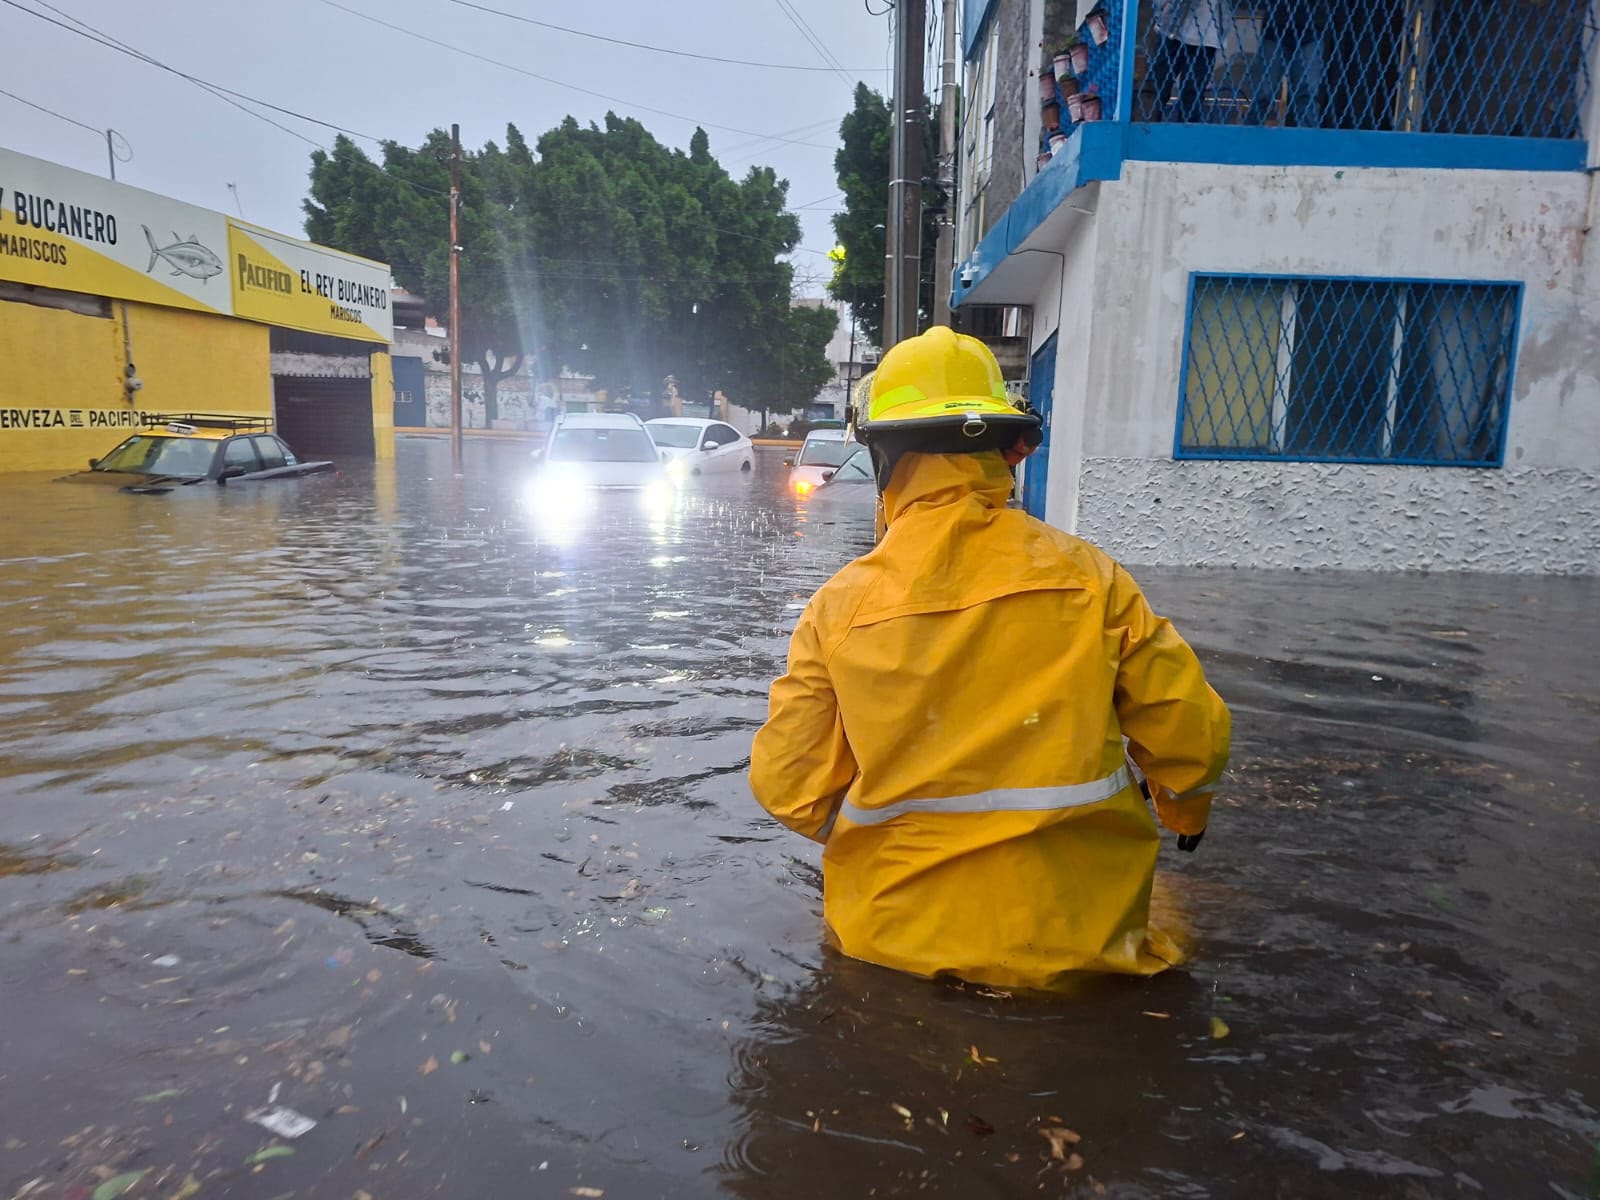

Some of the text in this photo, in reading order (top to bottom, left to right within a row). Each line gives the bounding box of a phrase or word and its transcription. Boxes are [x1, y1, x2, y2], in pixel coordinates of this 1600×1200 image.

[14, 190, 117, 245] BUCANERO
[0, 232, 67, 266] MARISCOS
[301, 269, 387, 310] EL REY BUCANERO
[330, 305, 362, 324] MARISCOS
